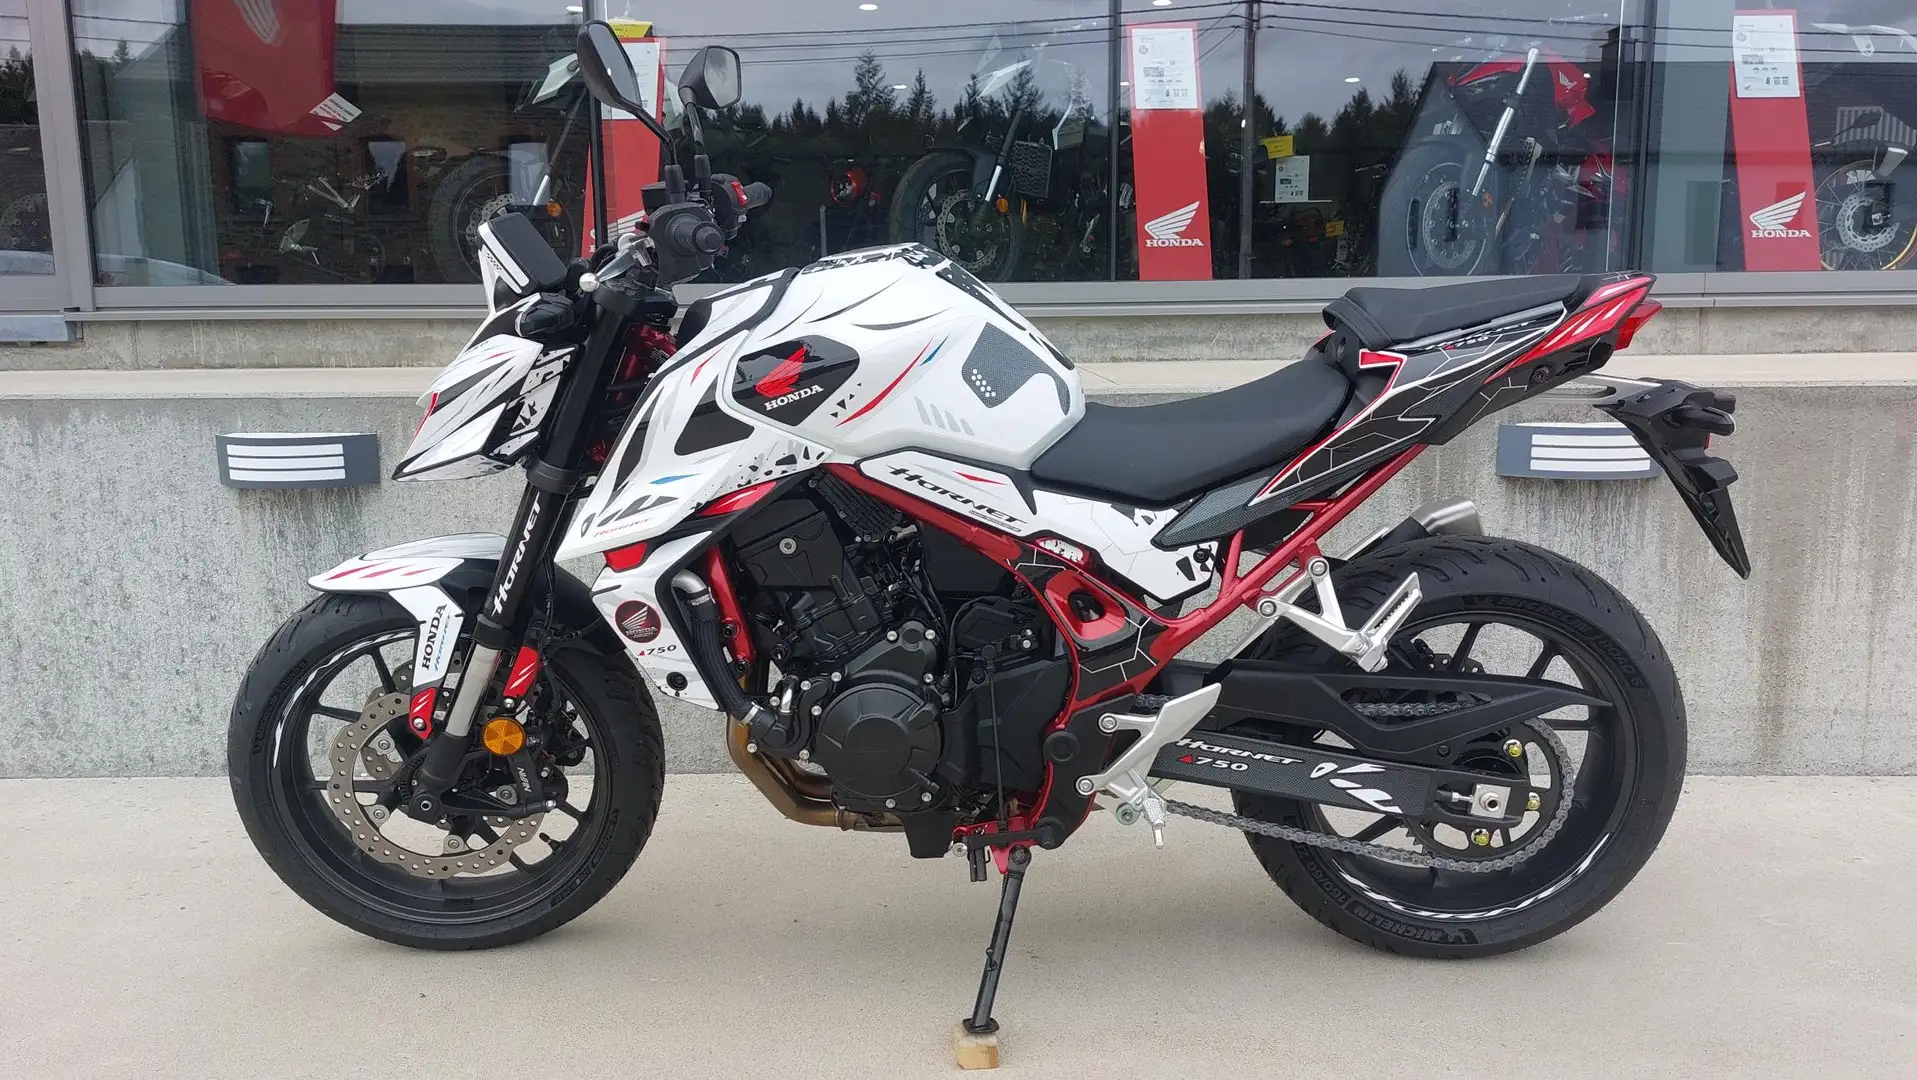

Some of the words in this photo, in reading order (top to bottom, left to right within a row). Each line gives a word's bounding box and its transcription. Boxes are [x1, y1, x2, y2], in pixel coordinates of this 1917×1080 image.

[1145, 239, 1204, 247] HONDA
[1751, 230, 1812, 238] HONDA
[764, 384, 824, 411] HONDA
[886, 464, 1028, 525] HORNET
[491, 491, 541, 617] HORNET
[421, 604, 448, 671] HONDA
[646, 644, 677, 656] 750
[1175, 738, 1304, 765] HORNET
[1194, 756, 1249, 771] 750
[1306, 860, 1349, 903] 160/60
[1352, 905, 1446, 942] MICHELIN
